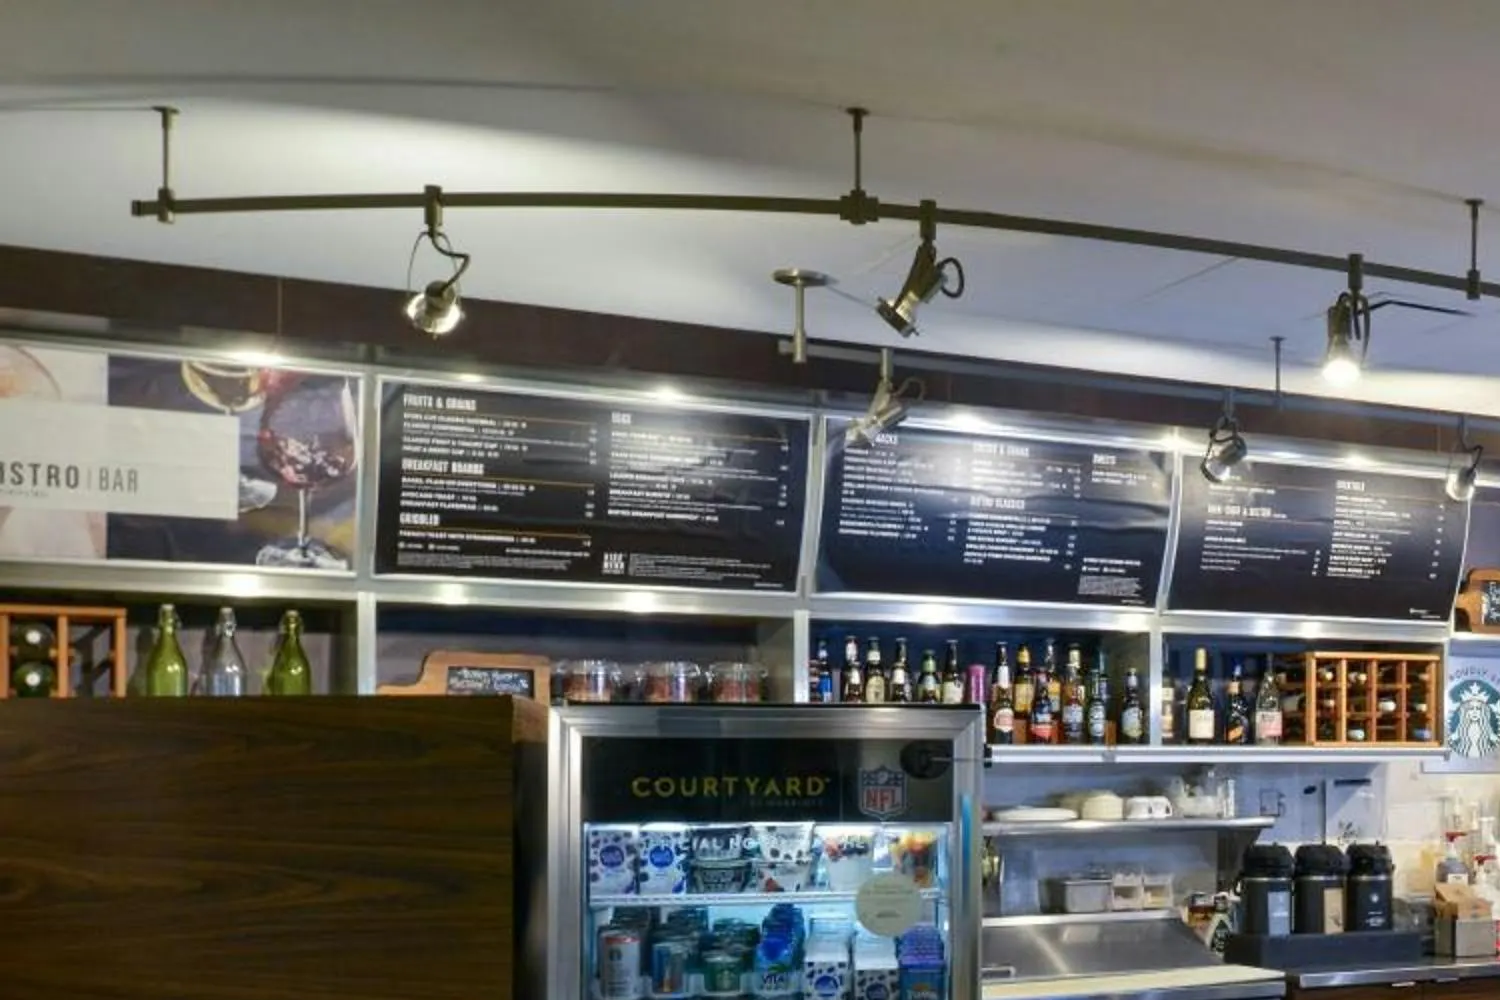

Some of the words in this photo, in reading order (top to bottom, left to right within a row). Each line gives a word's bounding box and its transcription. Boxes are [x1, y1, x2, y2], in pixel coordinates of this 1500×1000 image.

[0, 461, 80, 489] ISTRO
[98, 467, 139, 494] BAR
[632, 776, 827, 798] COURTYARD
[865, 788, 899, 812] NFL
